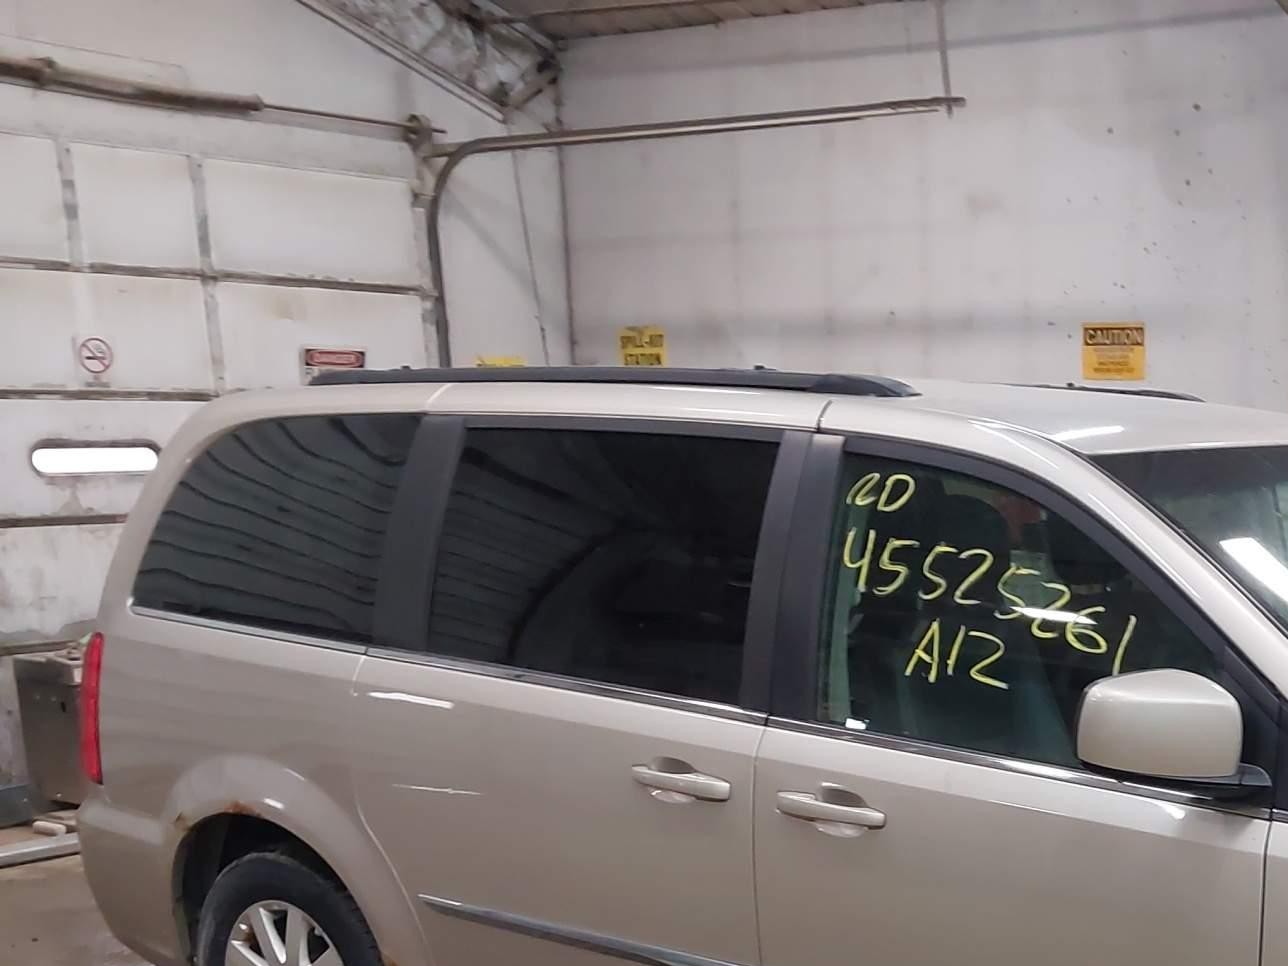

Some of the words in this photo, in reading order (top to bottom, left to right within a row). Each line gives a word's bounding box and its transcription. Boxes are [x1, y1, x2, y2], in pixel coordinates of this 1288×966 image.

[1086, 329, 1142, 346] CAUTION
[843, 527, 1137, 677] 45525261
[904, 617, 1009, 690] A12
